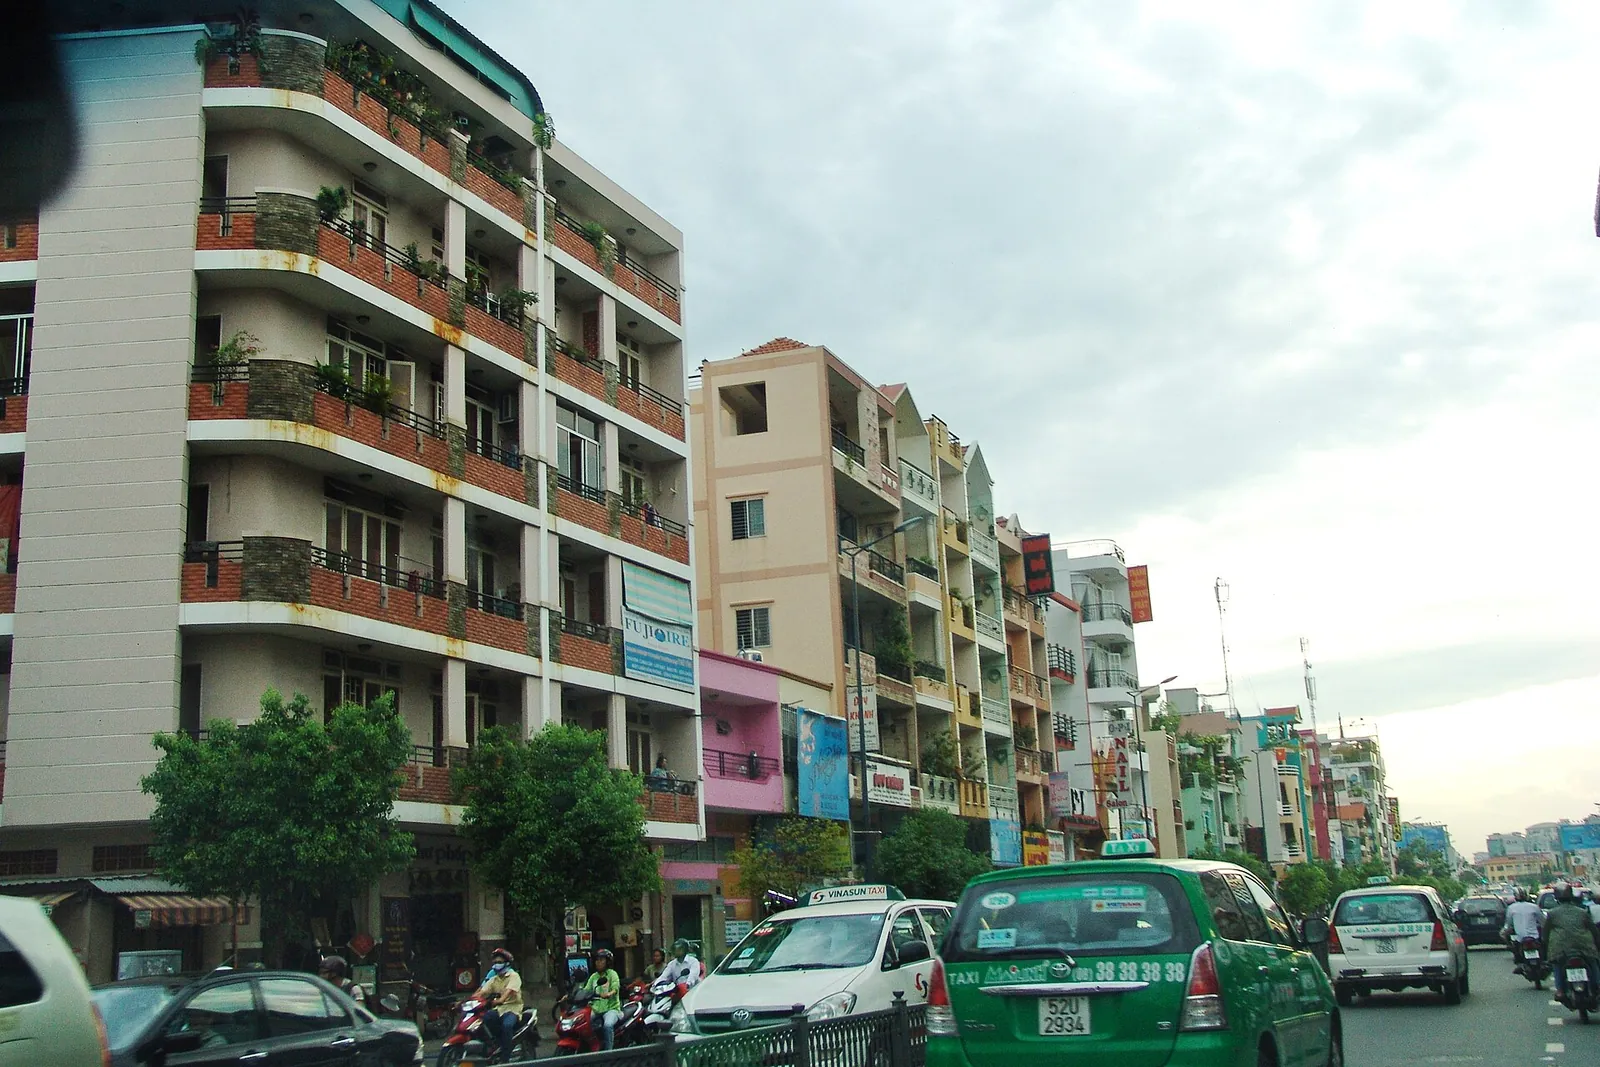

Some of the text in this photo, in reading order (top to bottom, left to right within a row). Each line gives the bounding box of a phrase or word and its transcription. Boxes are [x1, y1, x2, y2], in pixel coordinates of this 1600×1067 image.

[1114, 737, 1129, 792] NAIL
[1106, 799, 1128, 808] Salon
[828, 886, 885, 898] VINASUN TAXI
[948, 967, 980, 985] TAXI
[1096, 961, 1115, 981] 38
[1118, 961, 1138, 981] 38
[1141, 961, 1161, 981] 38
[1164, 962, 1185, 982] 38
[1048, 999, 1079, 1015] 52U
[1043, 1016, 1084, 1033] 2934
